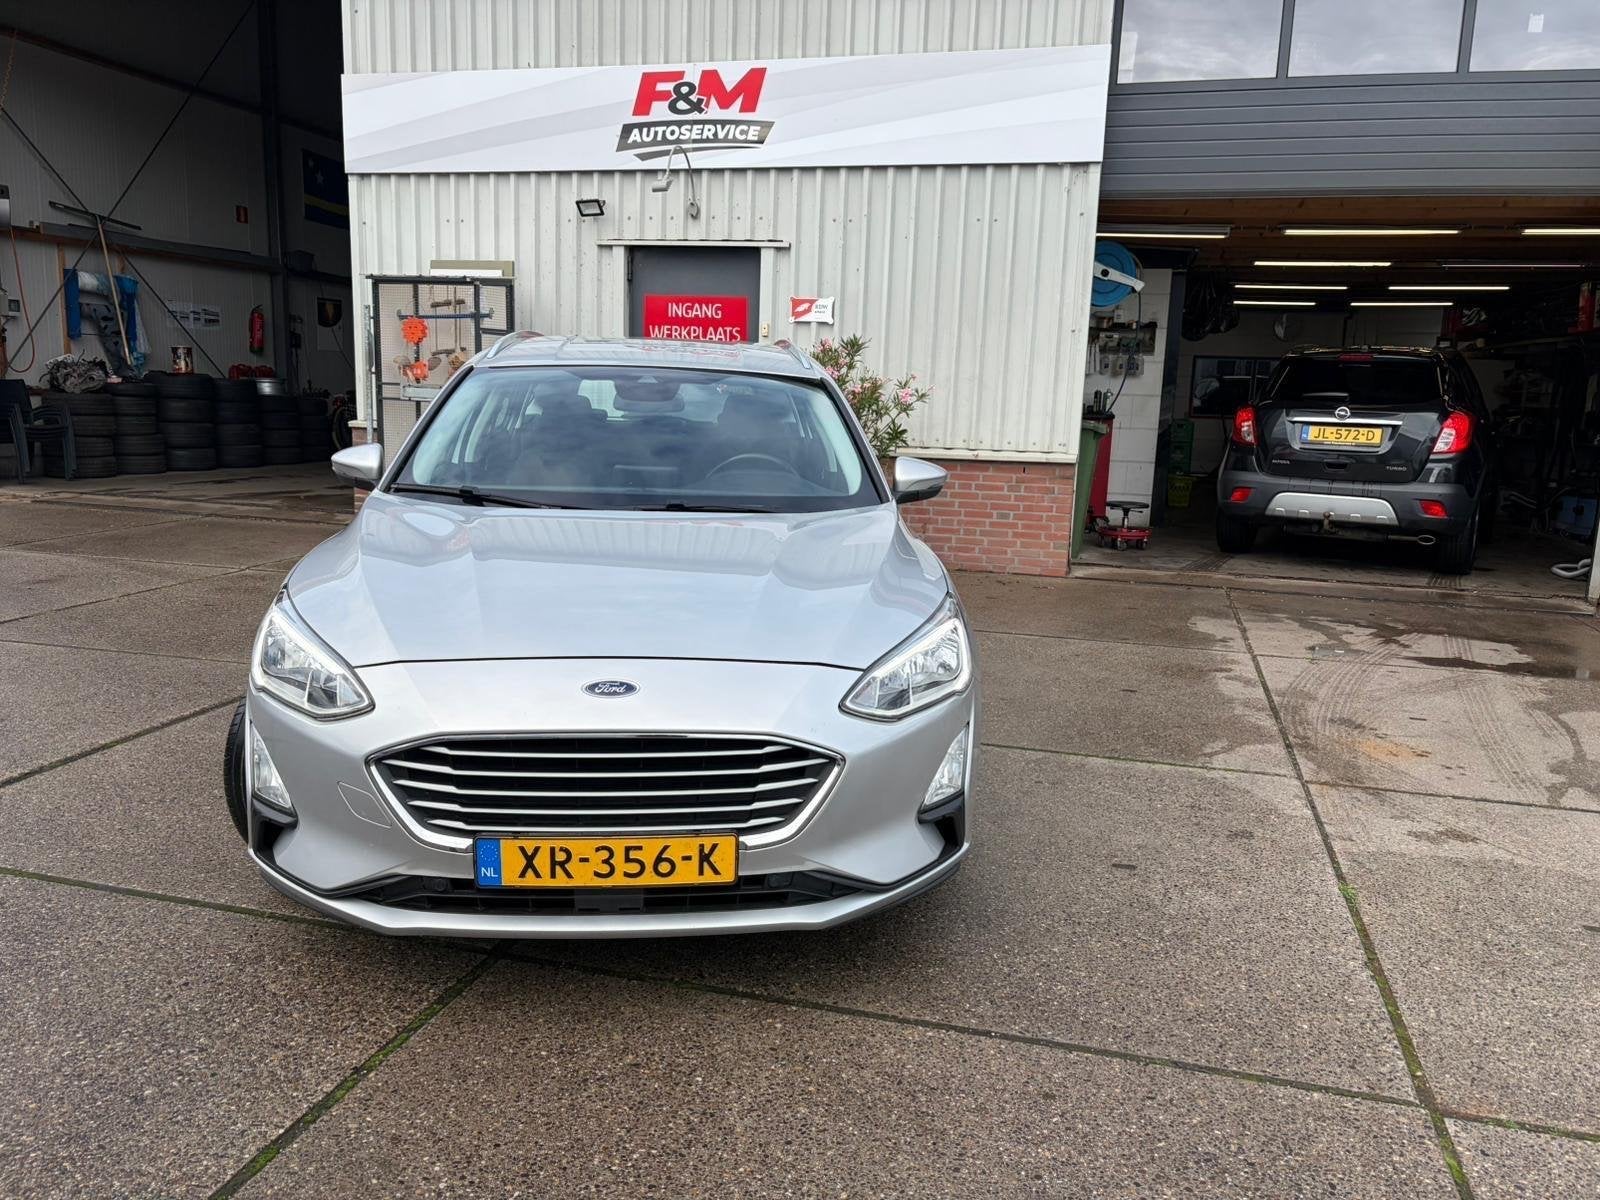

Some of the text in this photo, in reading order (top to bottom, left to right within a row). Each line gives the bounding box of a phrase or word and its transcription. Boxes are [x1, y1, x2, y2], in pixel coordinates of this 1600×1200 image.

[632, 67, 767, 116] F&M
[627, 124, 761, 144] AUTOSERVICE
[667, 302, 722, 319] INGANG
[649, 325, 741, 342] WERKPLAATS
[1314, 427, 1376, 441] JL-572-D
[595, 681, 627, 693] Ford
[517, 843, 721, 880] XR-356-K
[481, 867, 498, 877] NL
